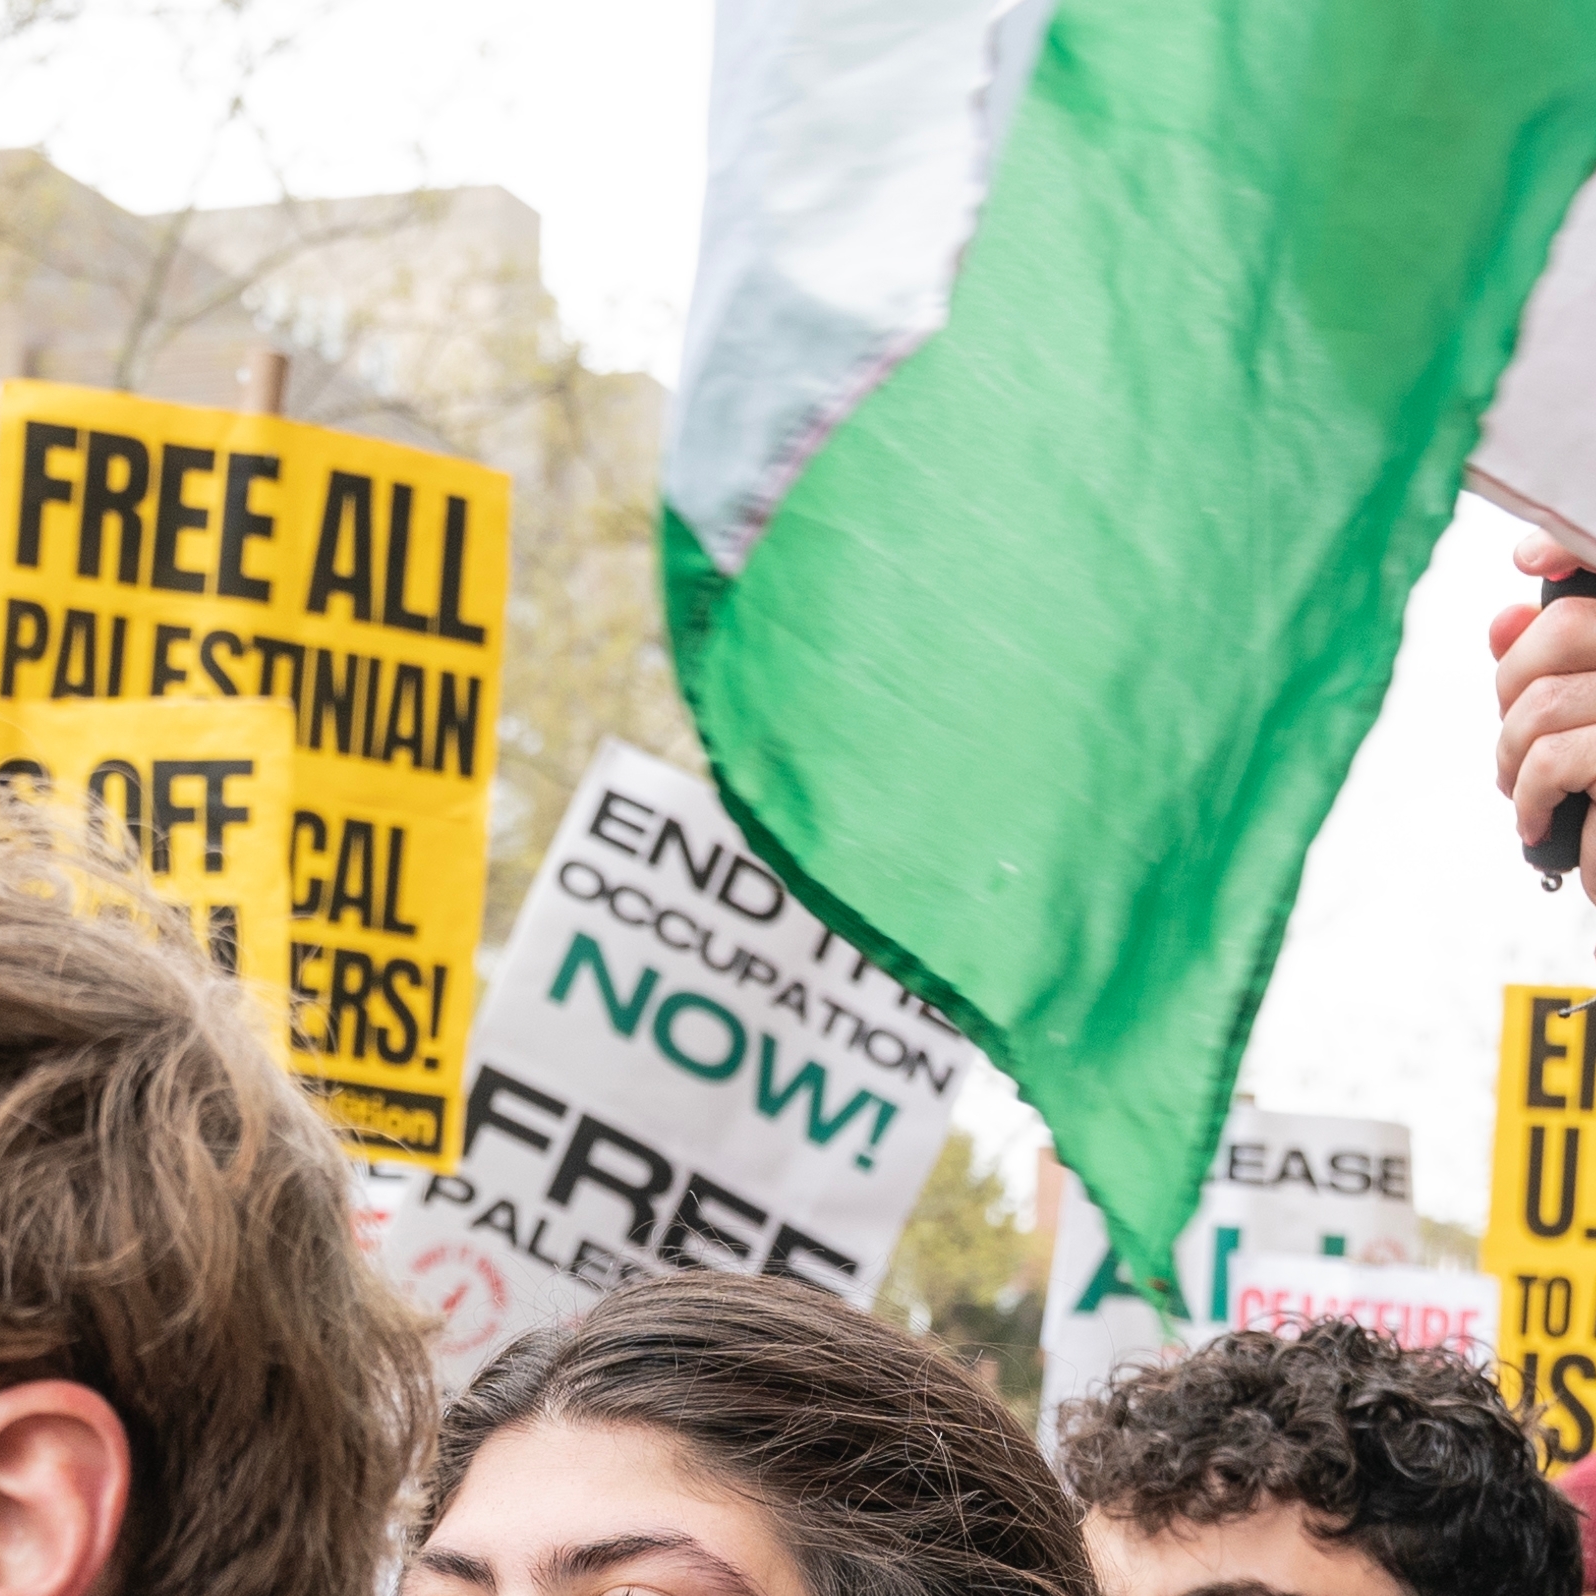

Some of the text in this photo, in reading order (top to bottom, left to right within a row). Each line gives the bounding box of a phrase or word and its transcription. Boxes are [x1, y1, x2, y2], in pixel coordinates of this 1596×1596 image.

[15, 420, 487, 646] FREE ALL
[87, 758, 254, 874] OFF
[587, 790, 787, 924] END
[548, 931, 901, 1173] NOW!
[557, 858, 955, 1097] OCCUPATION
[1517, 1276, 1573, 1339] TO
